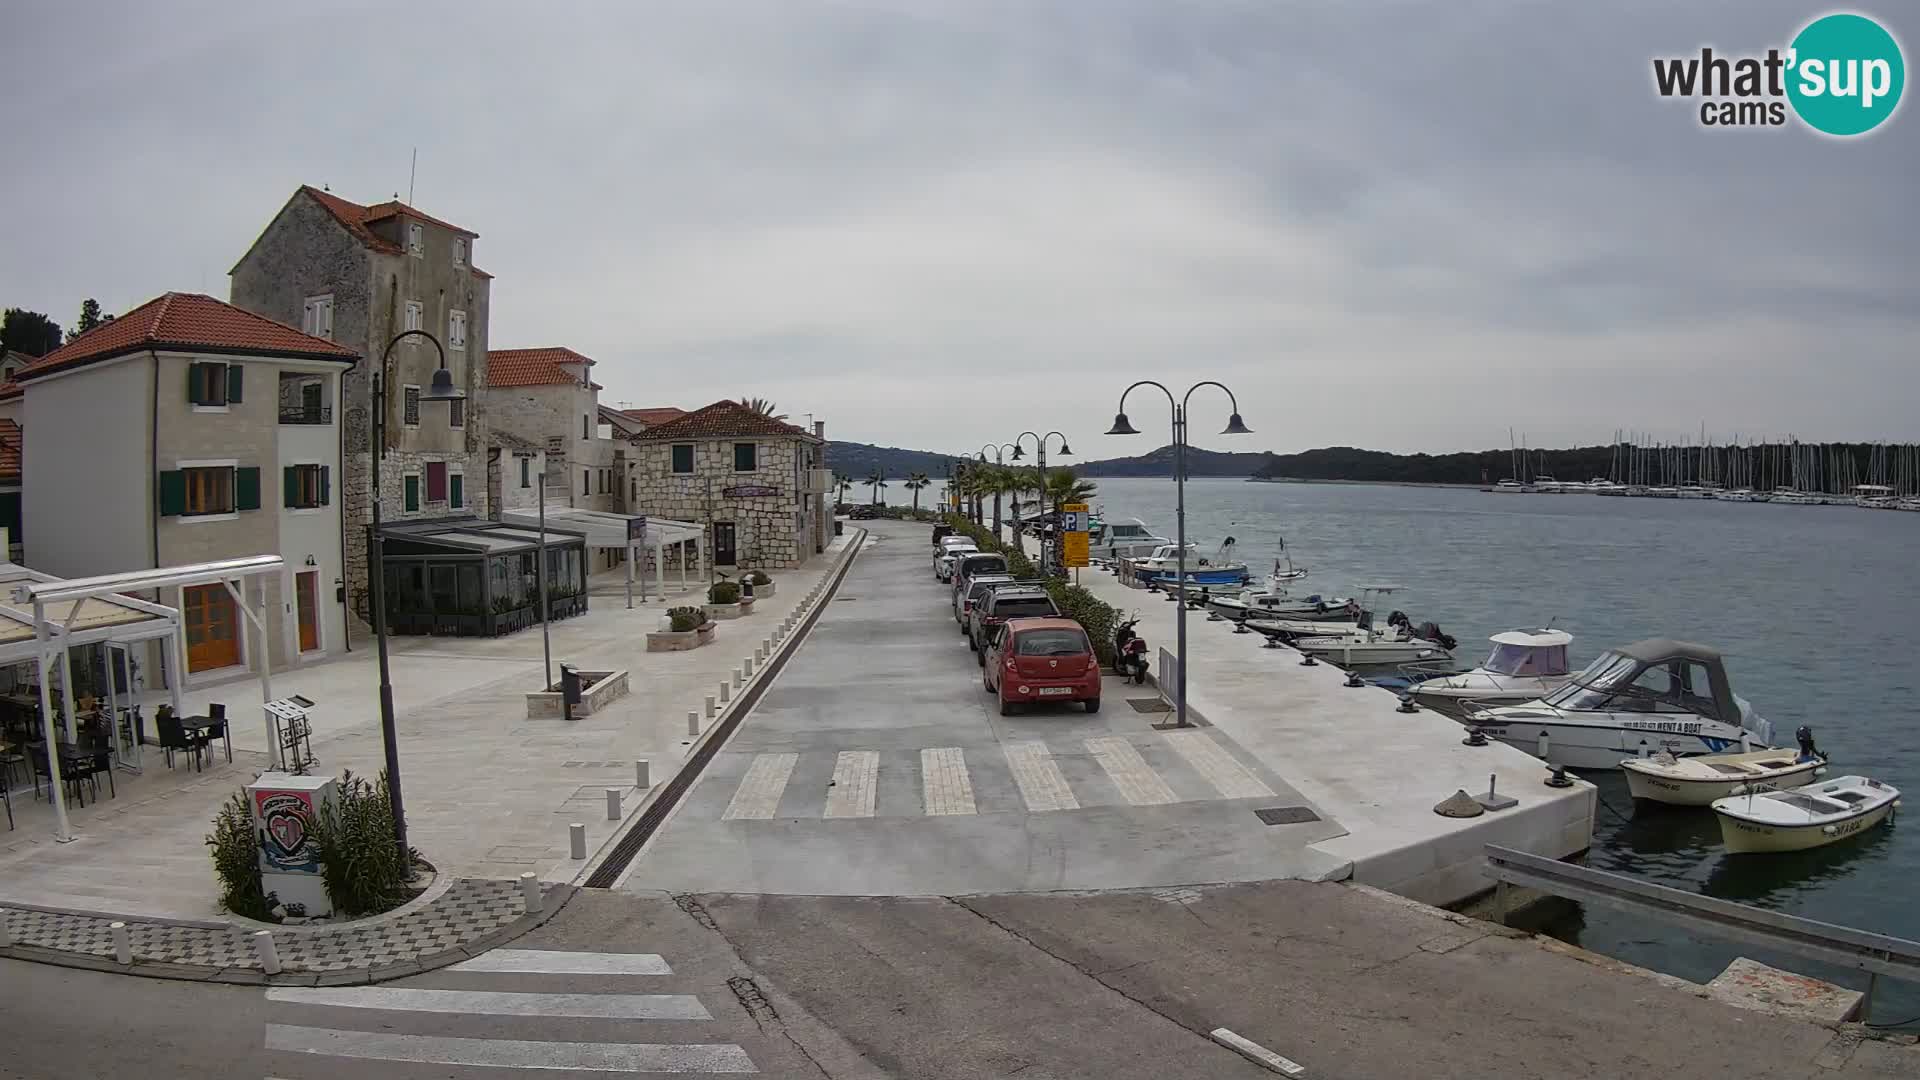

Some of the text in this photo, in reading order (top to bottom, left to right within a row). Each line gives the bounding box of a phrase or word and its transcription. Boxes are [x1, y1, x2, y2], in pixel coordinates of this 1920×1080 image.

[1065, 514, 1076, 529] P
[1657, 722, 1677, 732] RENT
[1684, 723, 1702, 734] BOAT
